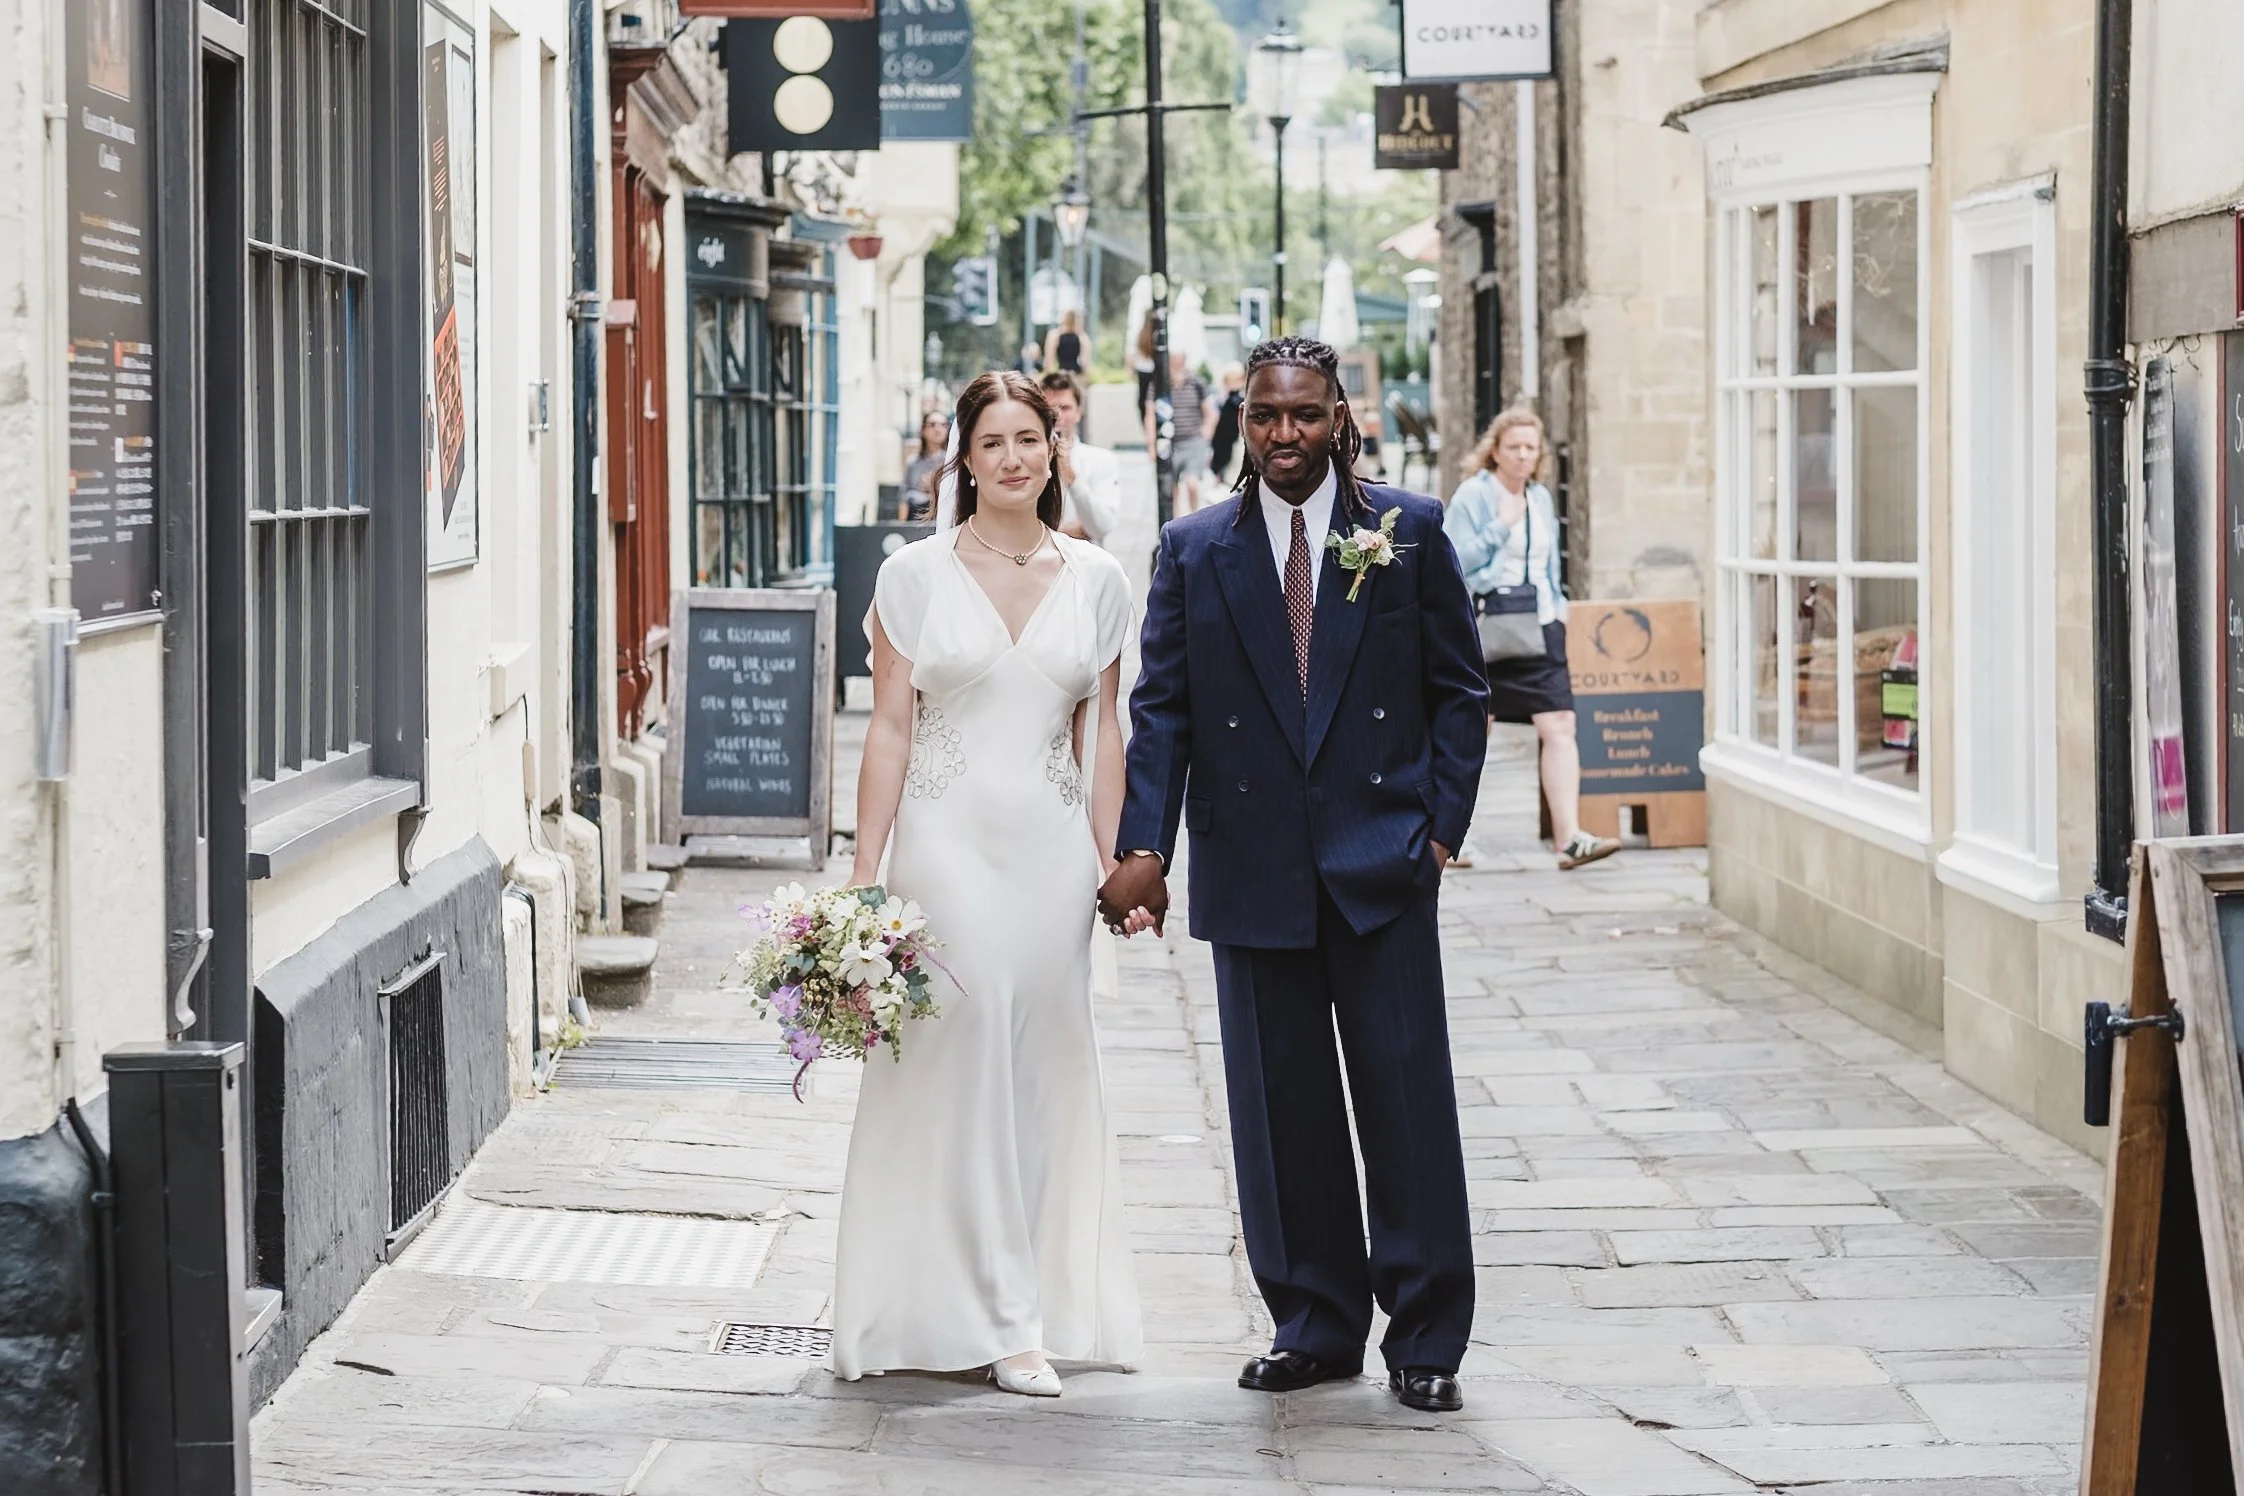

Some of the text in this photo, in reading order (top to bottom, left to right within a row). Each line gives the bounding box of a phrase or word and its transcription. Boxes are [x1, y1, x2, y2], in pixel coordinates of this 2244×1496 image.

[1417, 24, 1540, 43] COURTYARD
[707, 655, 737, 671] OPEN
[1593, 708, 1660, 724] Breakfast
[1602, 727, 1654, 742] Brunch
[1607, 745, 1651, 760] Lunch
